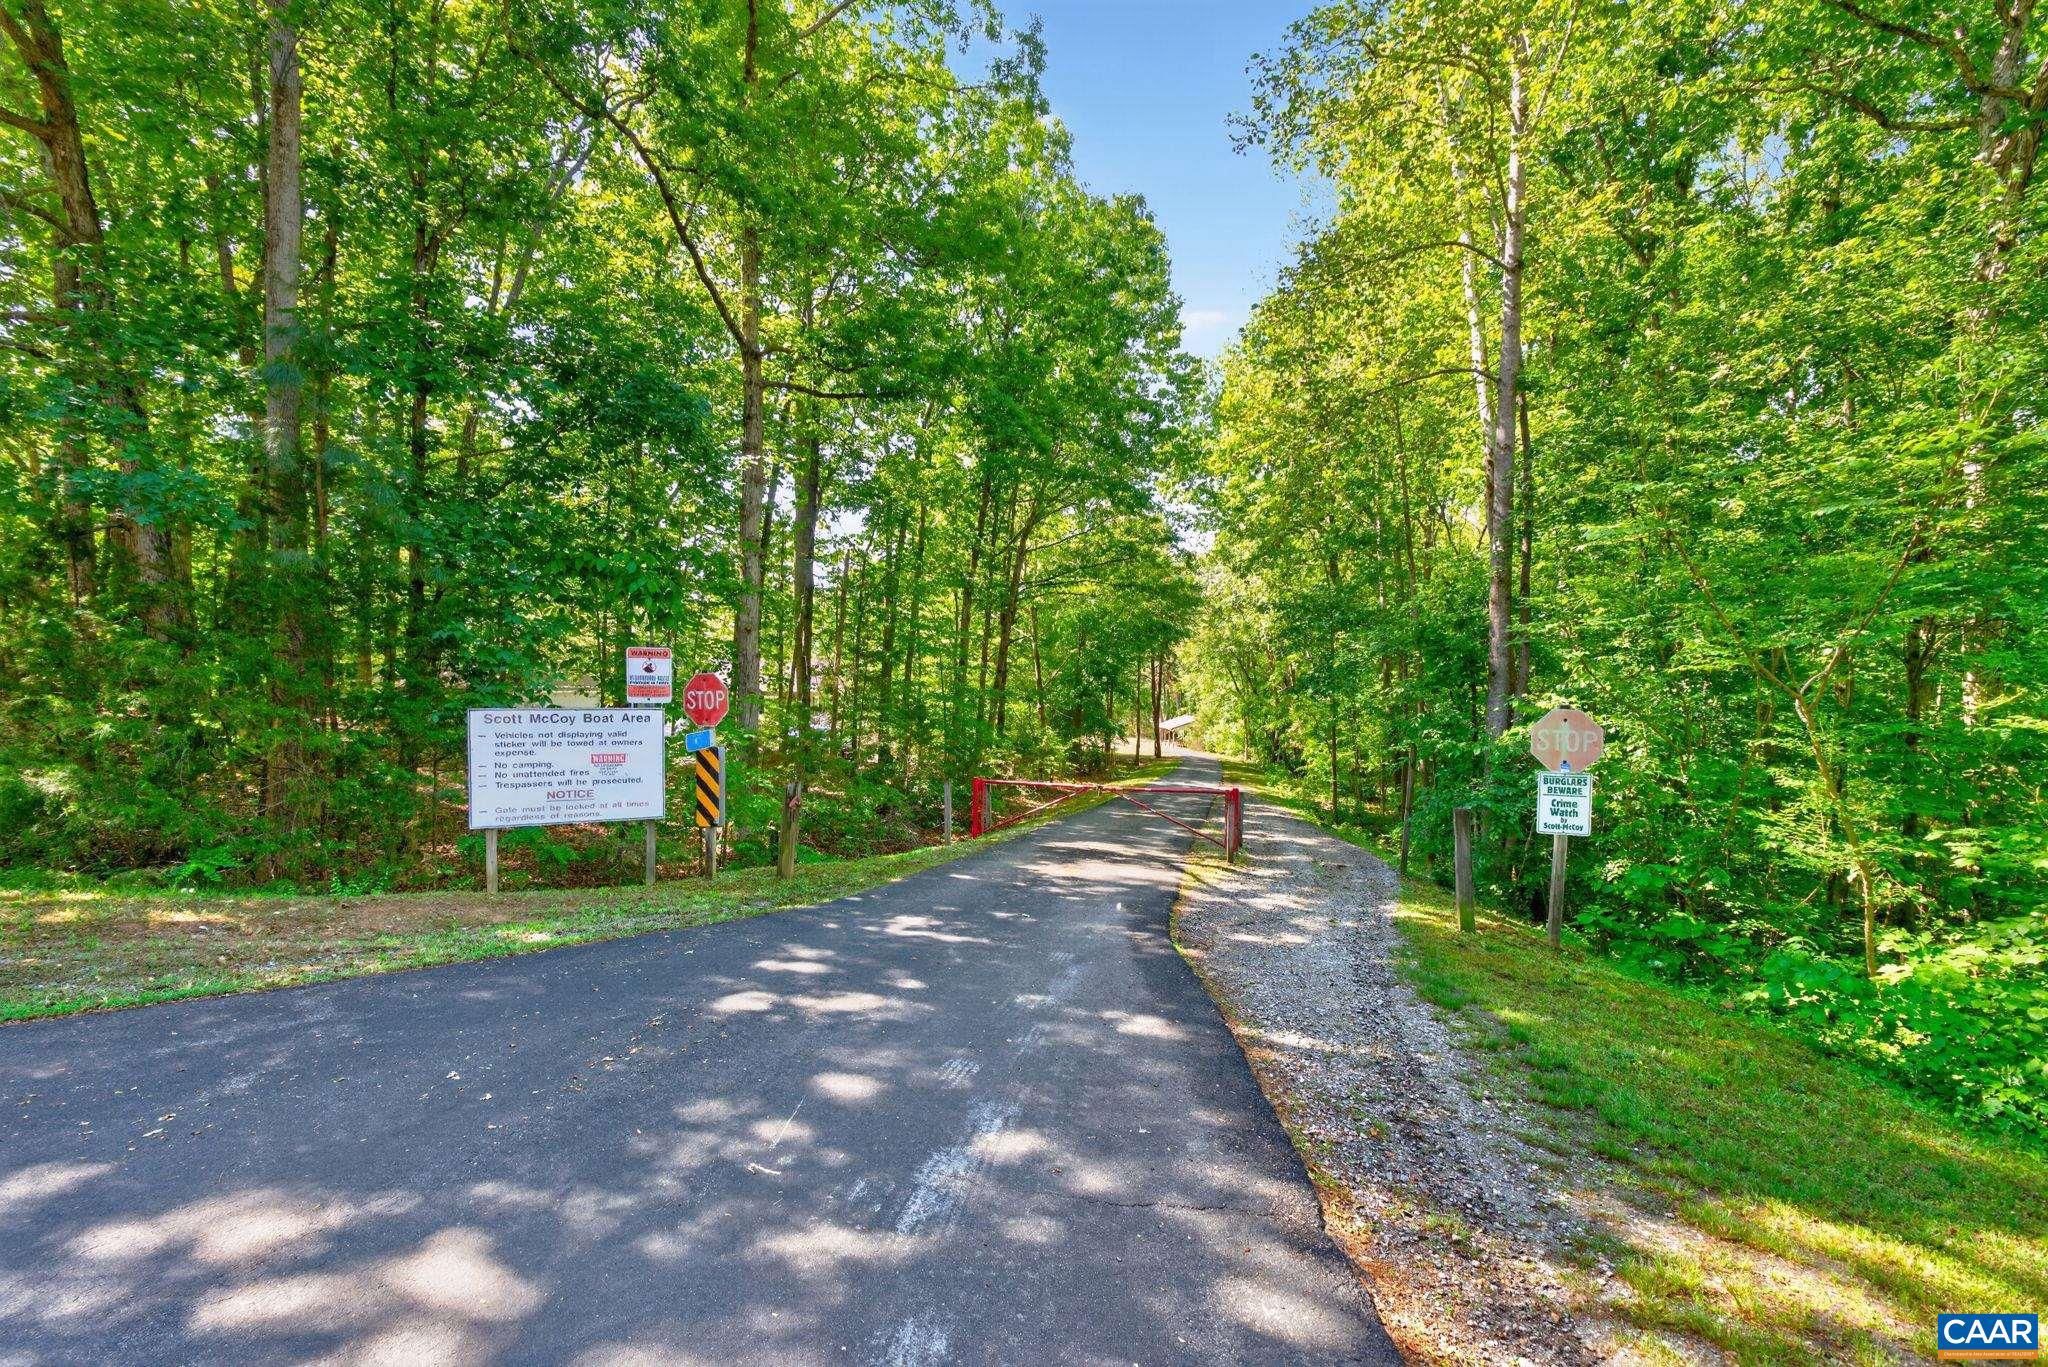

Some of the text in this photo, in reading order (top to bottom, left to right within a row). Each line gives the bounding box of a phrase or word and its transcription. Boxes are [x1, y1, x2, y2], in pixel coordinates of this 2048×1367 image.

[687, 690, 725, 710] STOP
[483, 713, 651, 725] Scott McCoy Boat Area
[558, 731, 603, 739] displaying
[567, 739, 594, 747] towed
[1537, 729, 1598, 752] STOP
[592, 754, 624, 763] WARNING
[512, 770, 565, 778] unattended
[496, 781, 553, 789] Trespassers
[1543, 777, 1588, 787] BURGLARS
[546, 790, 595, 799] NOTICE
[1547, 786, 1583, 795] BEWARE
[1551, 799, 1578, 808] Crime
[1550, 808, 1579, 818] Watch
